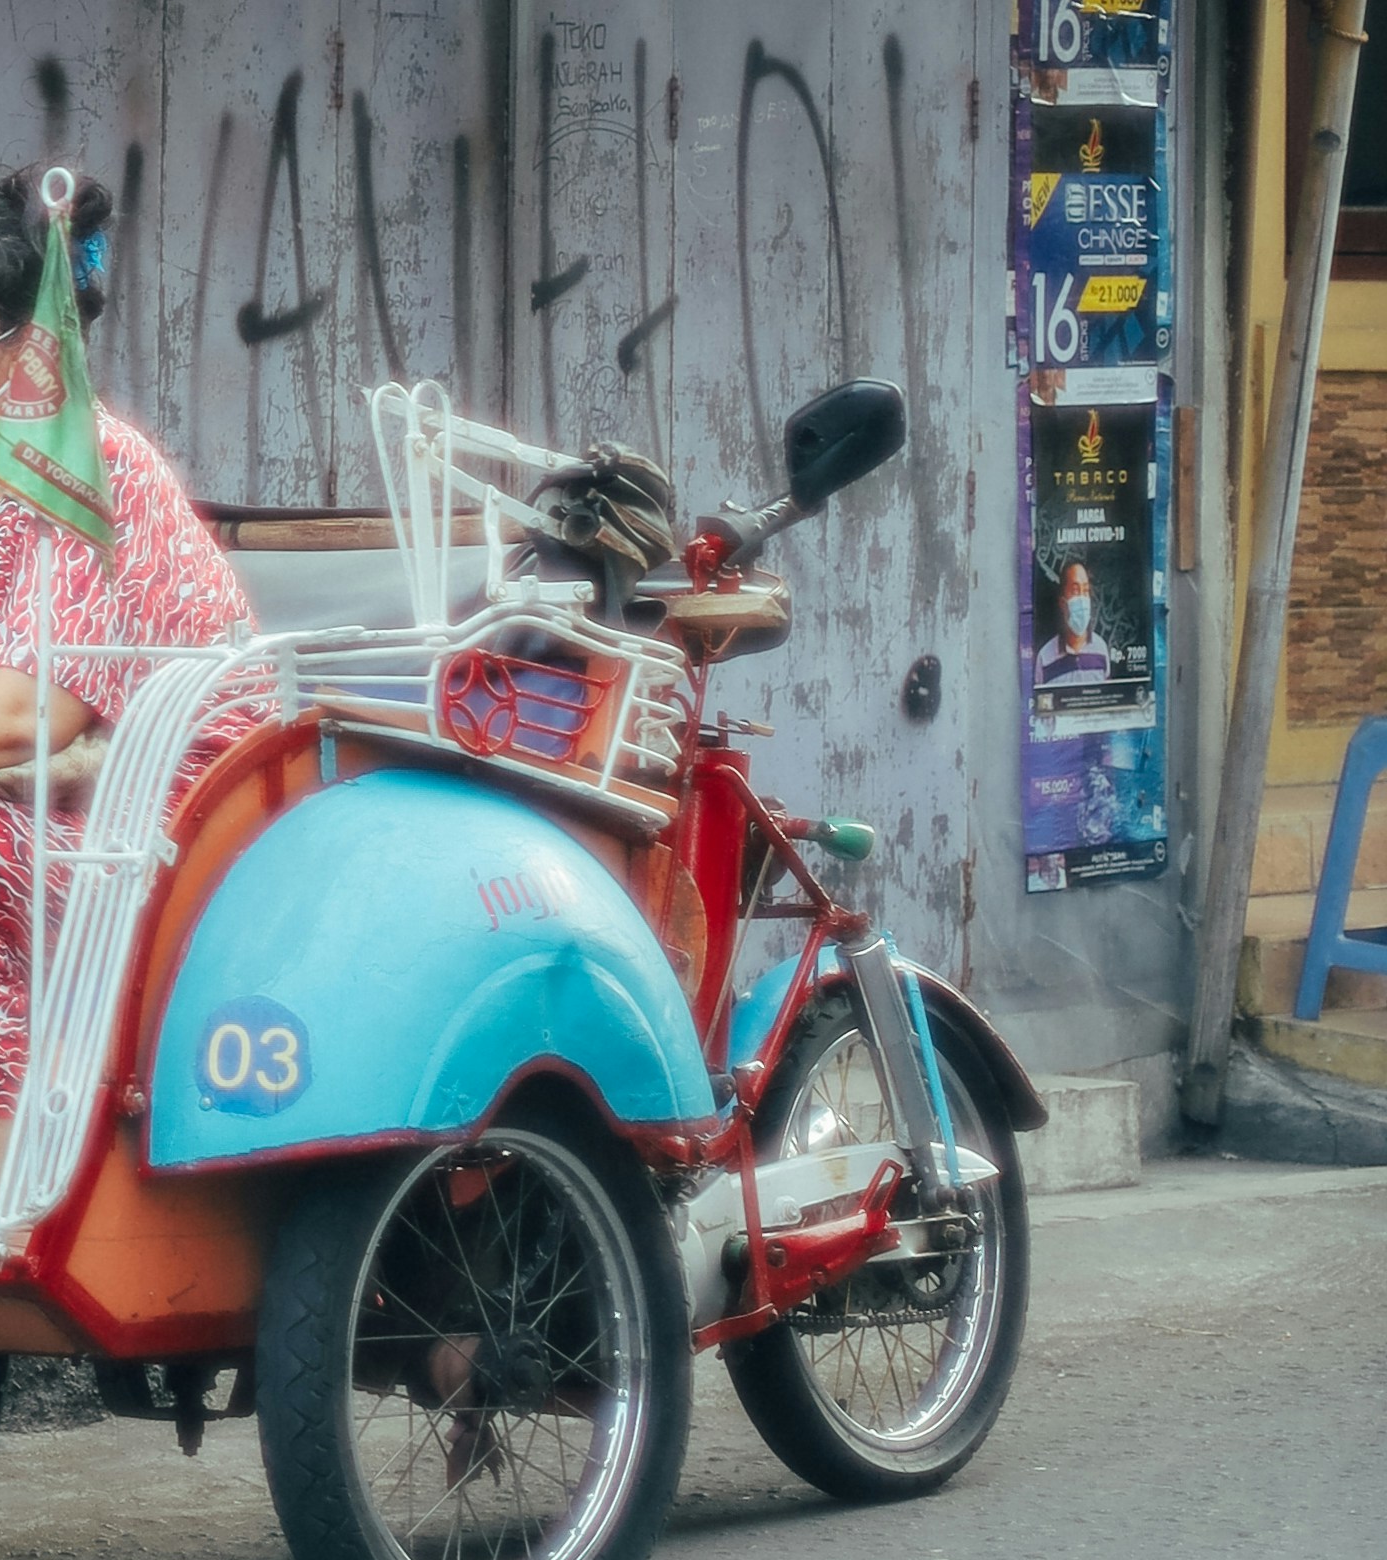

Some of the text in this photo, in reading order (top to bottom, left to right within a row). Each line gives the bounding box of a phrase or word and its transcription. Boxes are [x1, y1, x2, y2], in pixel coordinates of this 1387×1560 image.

[555, 22, 607, 54] TOKO
[1032, 177, 1051, 215] NEW
[1089, 183, 1147, 223] ESSE
[1078, 228, 1147, 255] CHANGE
[1032, 271, 1078, 363] 16
[1080, 319, 1088, 362] STICKS
[1054, 470, 1128, 486] TABACO
[1077, 508, 1105, 523] HARGA
[1057, 526, 1125, 544] LAWAN COVID-19
[207, 1023, 300, 1092] 03
